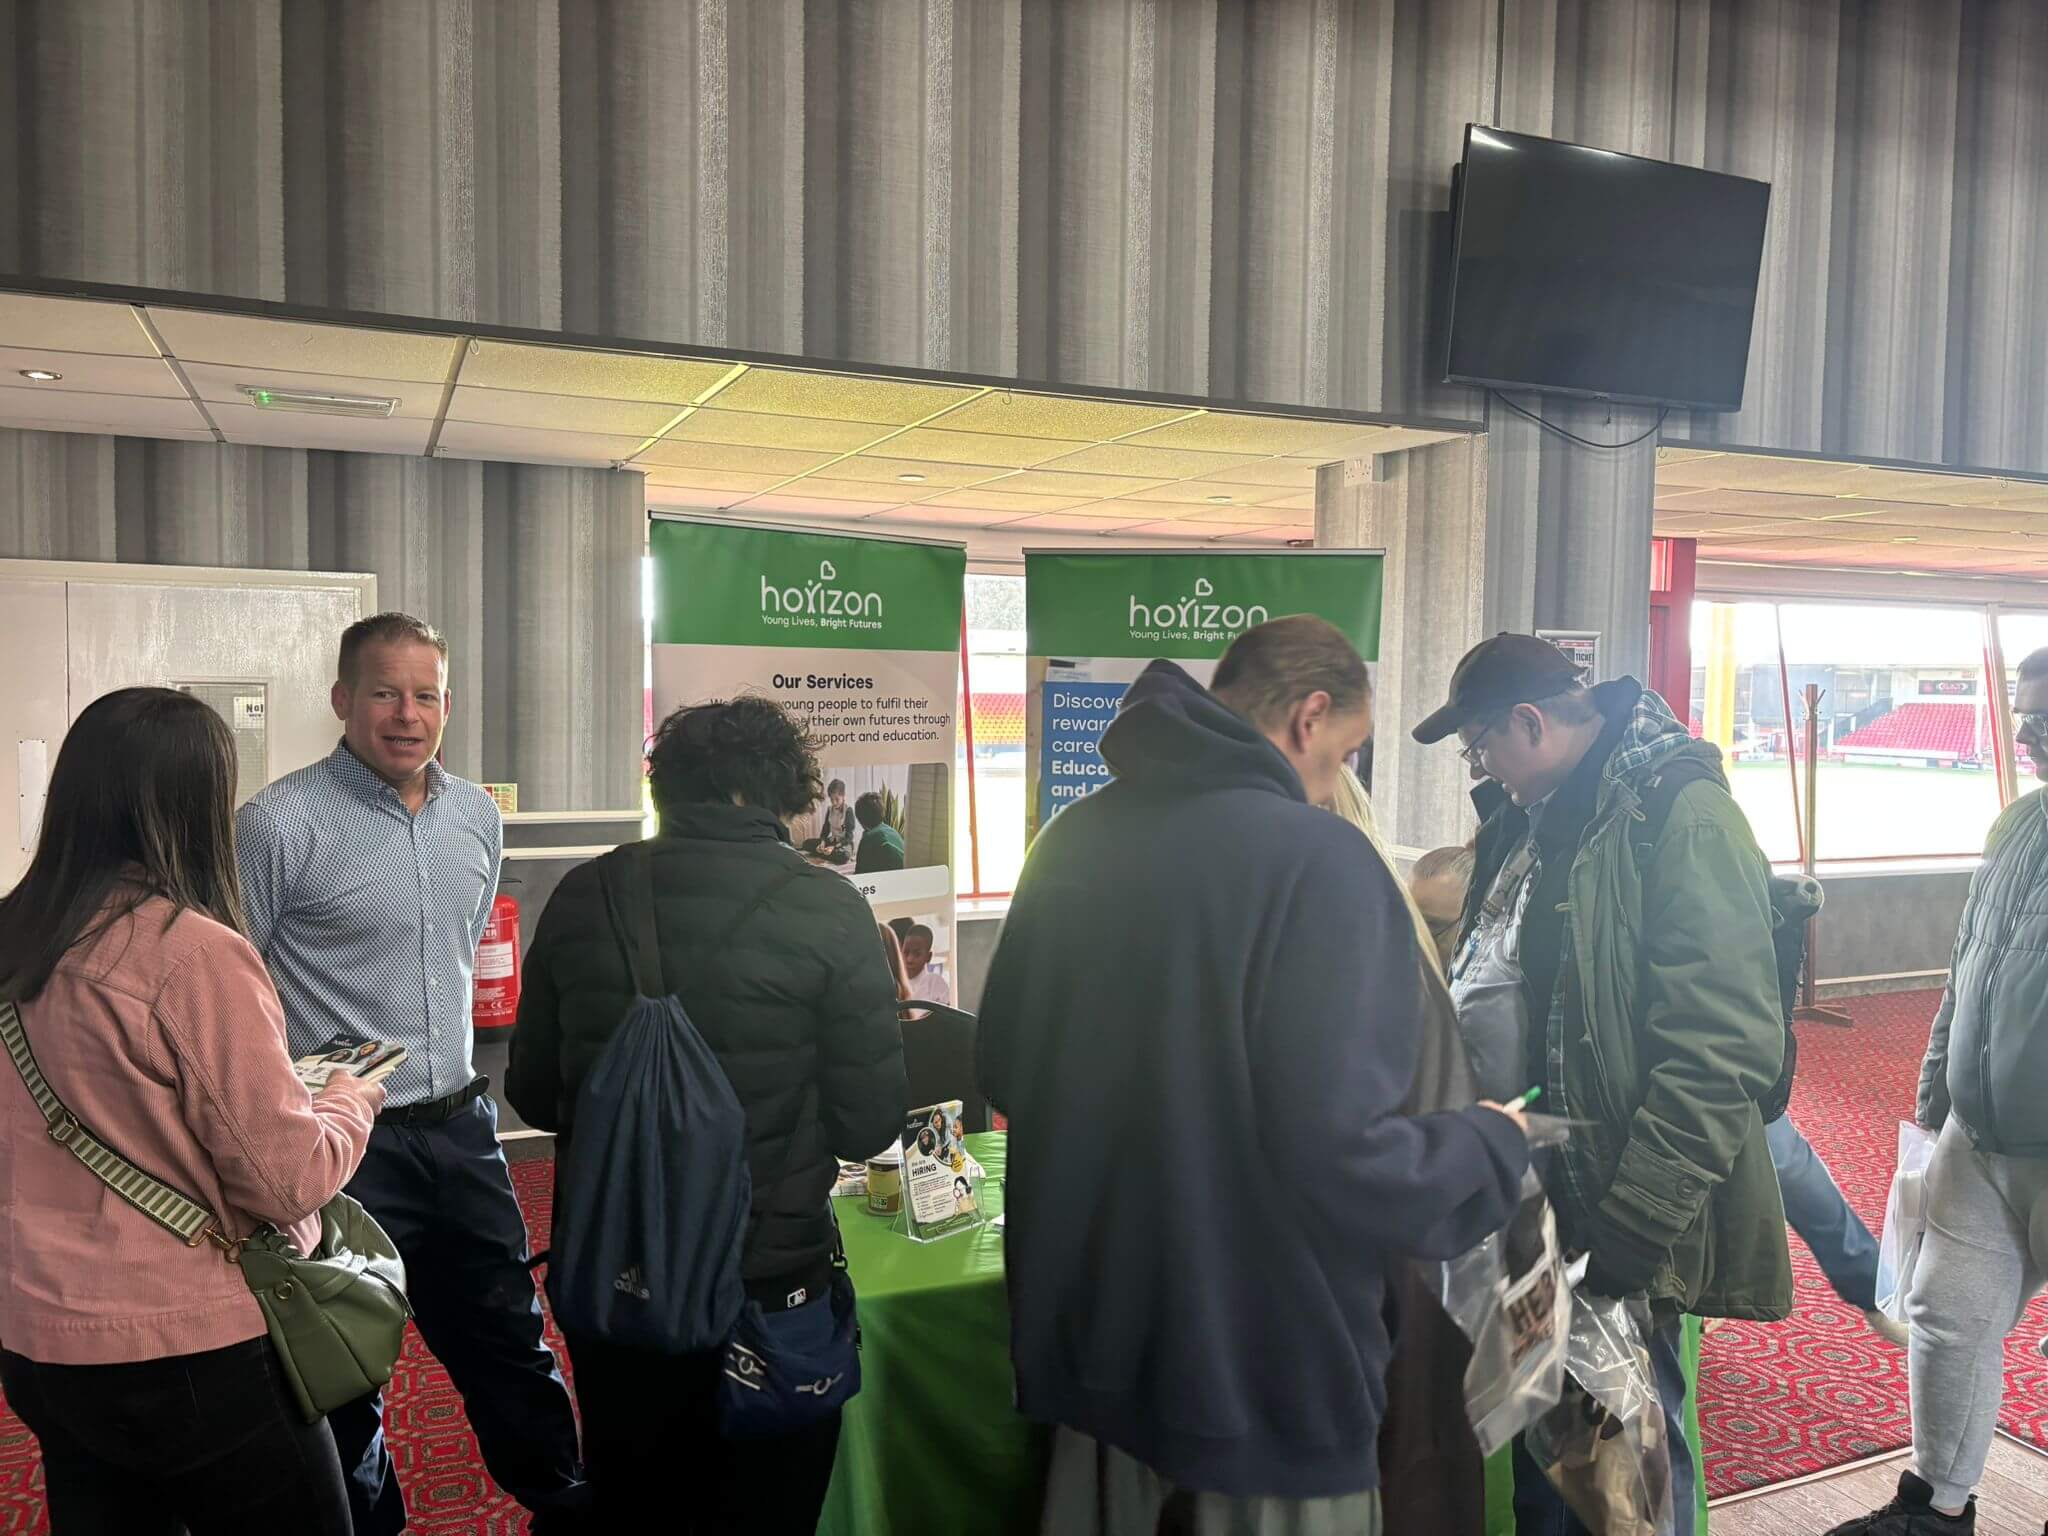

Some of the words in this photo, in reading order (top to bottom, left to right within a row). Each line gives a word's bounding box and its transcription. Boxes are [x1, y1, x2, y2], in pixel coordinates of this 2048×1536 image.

[761, 575, 882, 617] horizon
[1129, 594, 1268, 629] horizon
[762, 615, 790, 628] Young
[791, 616, 818, 628] Lives,
[820, 617, 848, 630] Bright
[849, 618, 882, 630] Futures
[1129, 629, 1161, 642] Young
[1162, 629, 1191, 641] Lives,
[1193, 630, 1225, 642] Bright
[772, 673, 802, 690] Our
[806, 672, 874, 690] Services
[817, 697, 858, 713] people
[860, 698, 873, 710] to
[876, 696, 901, 710] fulfil
[903, 697, 929, 710] their
[1053, 691, 1124, 709] Discove
[811, 714, 840, 727] their
[843, 717, 866, 727] own
[869, 713, 911, 727] futures
[913, 713, 951, 728] through
[810, 732, 856, 746] support
[858, 730, 880, 743] and
[882, 729, 940, 743] education.
[1052, 740, 1100, 754] care
[1051, 759, 1109, 776] Educa
[1051, 782, 1087, 797] and
[911, 1163, 937, 1177] HIRING
